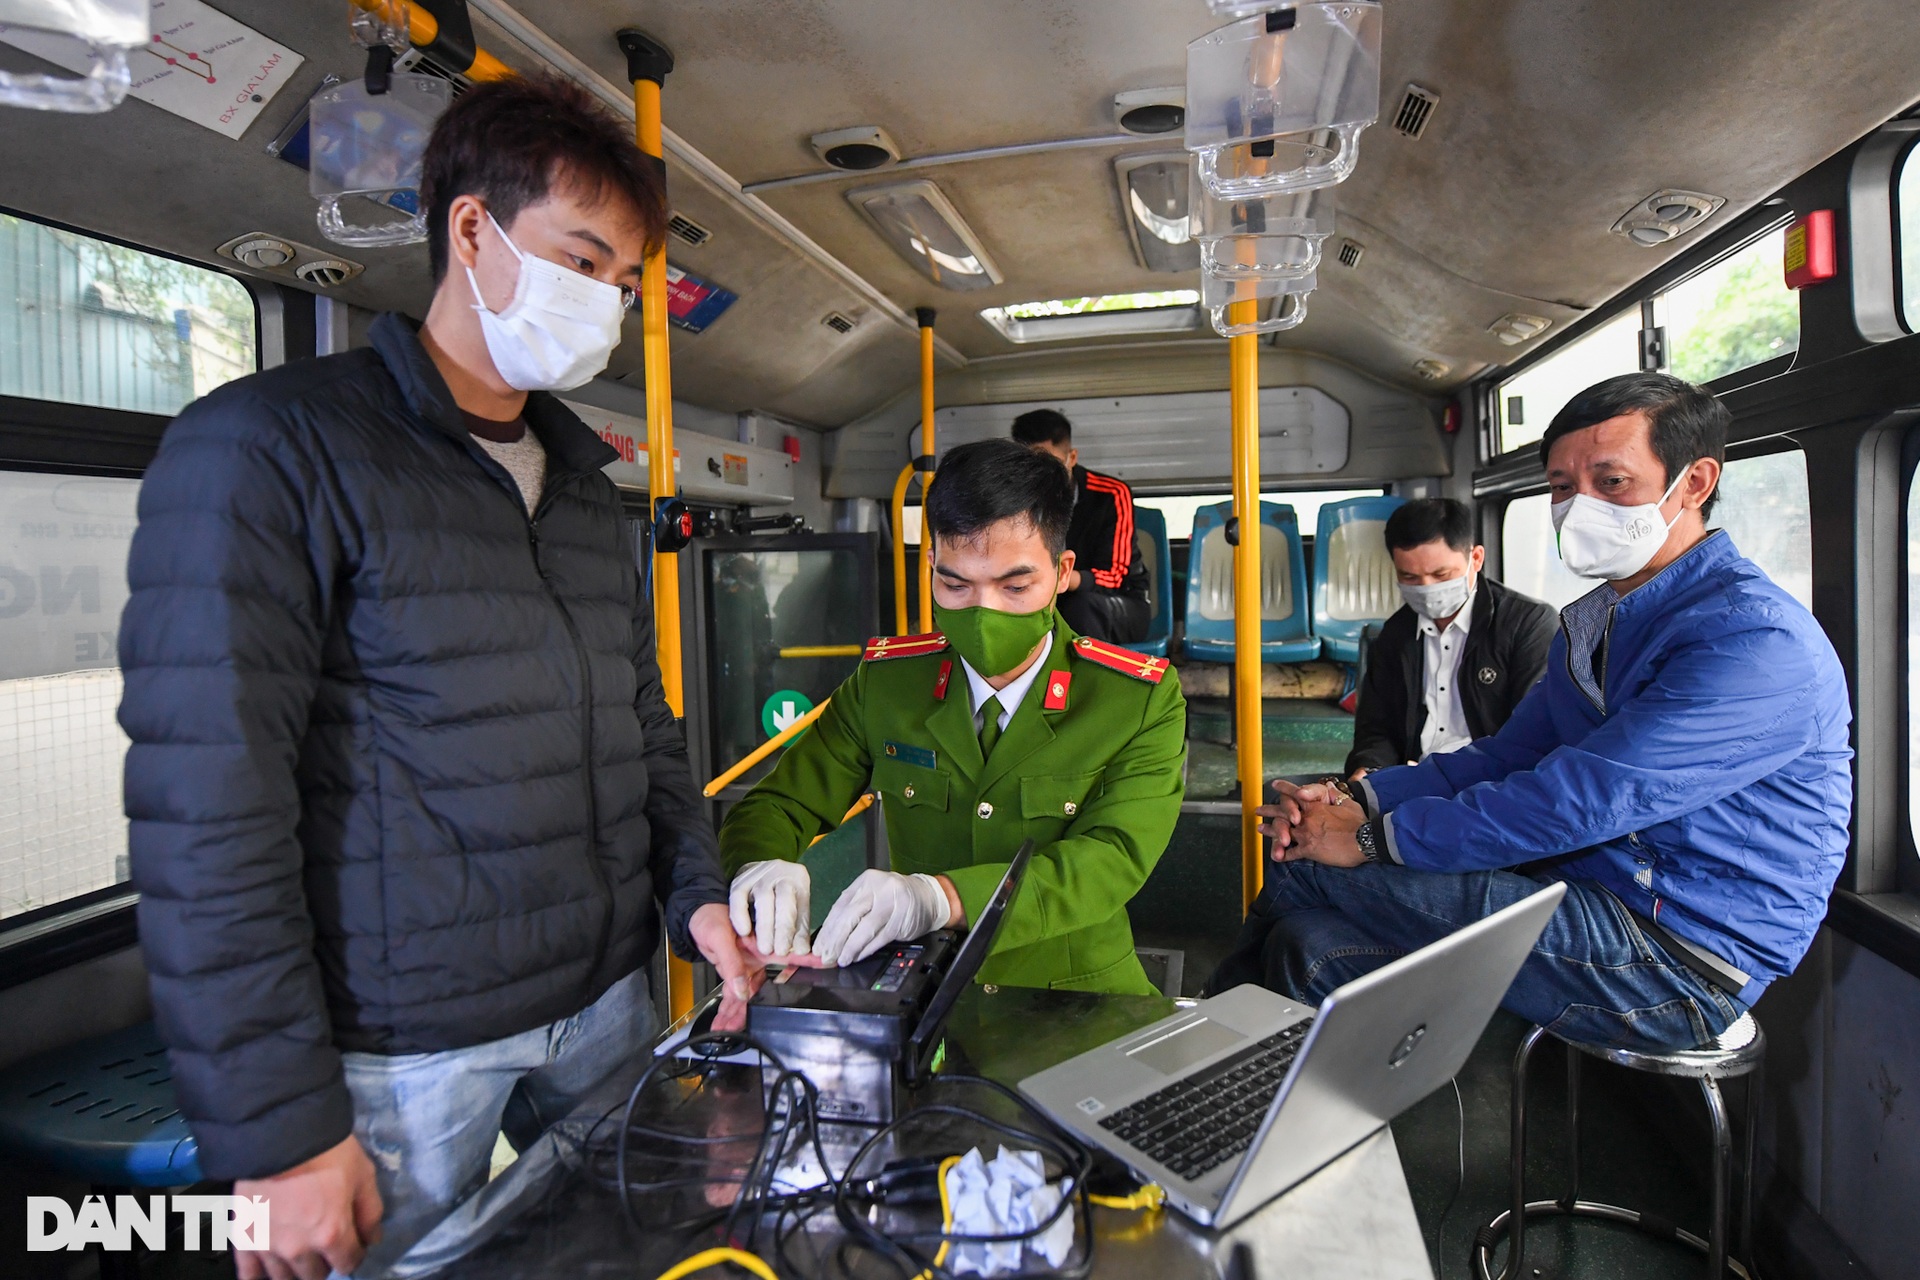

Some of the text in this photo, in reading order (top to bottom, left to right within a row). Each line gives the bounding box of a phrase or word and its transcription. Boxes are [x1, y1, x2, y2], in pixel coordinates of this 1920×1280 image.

[219, 53, 282, 123] BX GIA LÂM
